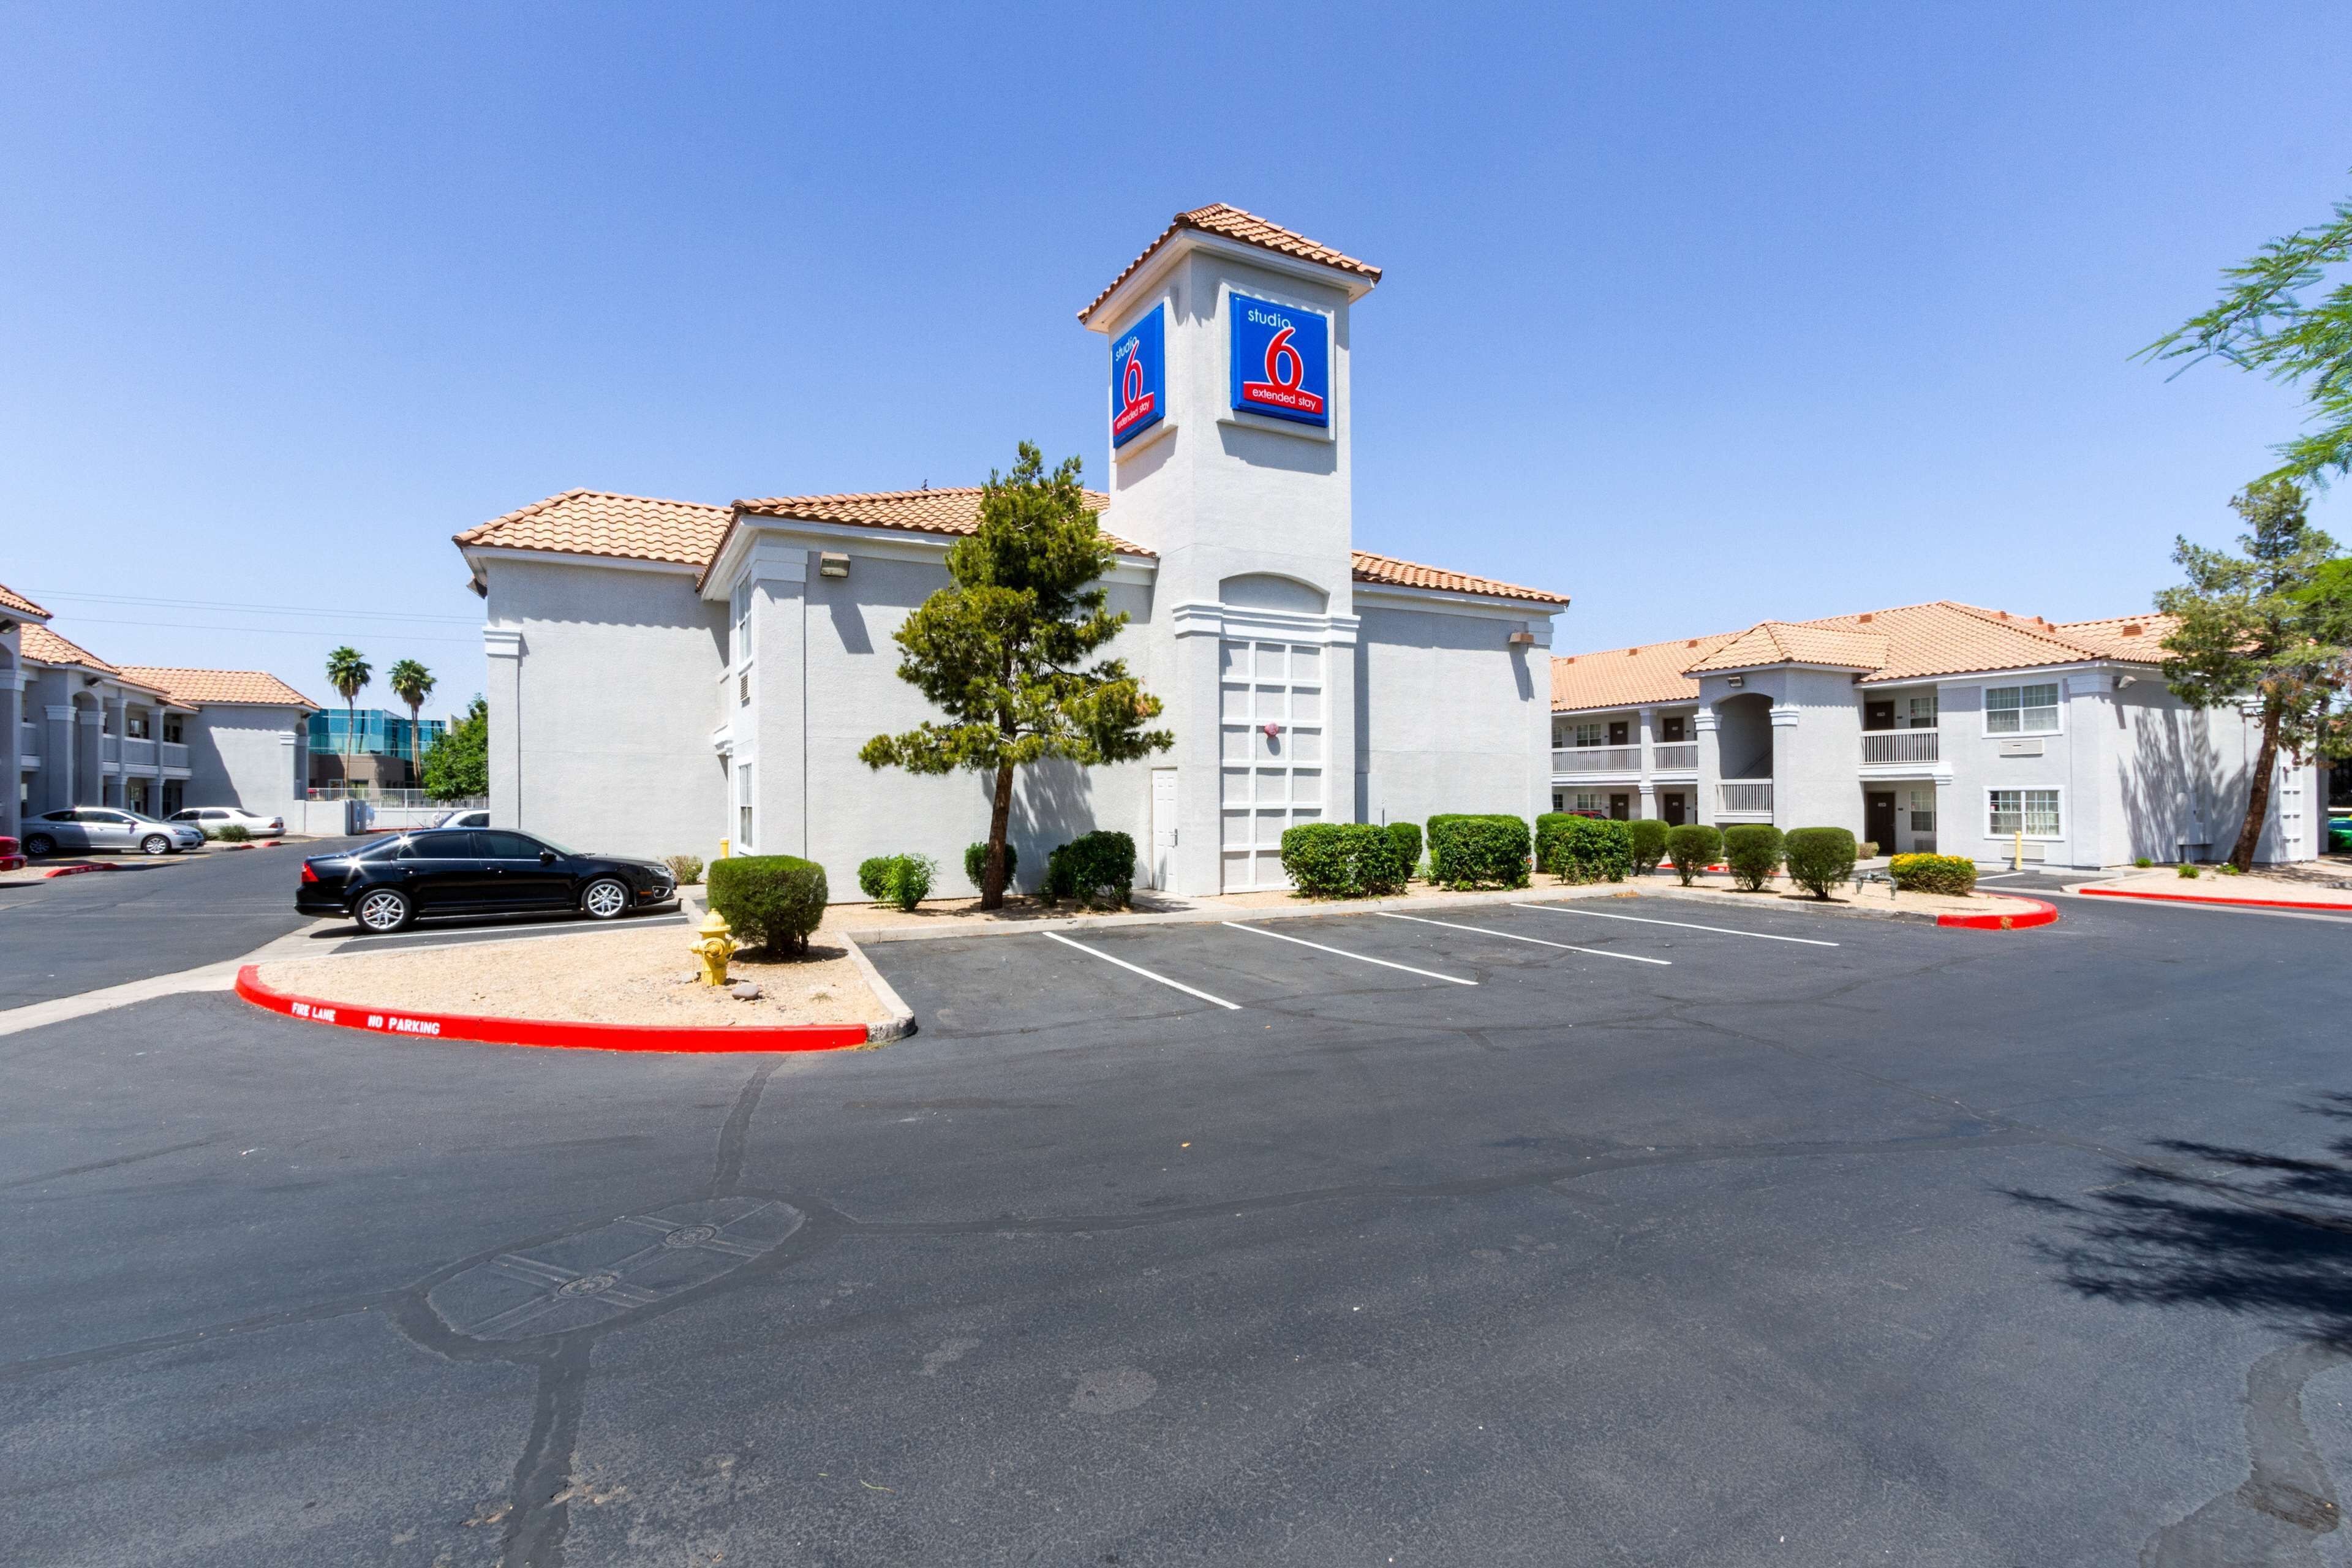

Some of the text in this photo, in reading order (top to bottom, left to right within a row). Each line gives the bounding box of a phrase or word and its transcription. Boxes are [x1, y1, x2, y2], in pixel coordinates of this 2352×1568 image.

[1248, 308, 1291, 329] studio
[1115, 336, 1137, 361] studio
[1265, 326, 1304, 390] 6
[1123, 340, 1144, 409] 6
[1253, 388, 1316, 410] extended stay
[1117, 401, 1150, 429] extended stay
[292, 1002, 440, 1035] FIRE LANE NO PARKING
